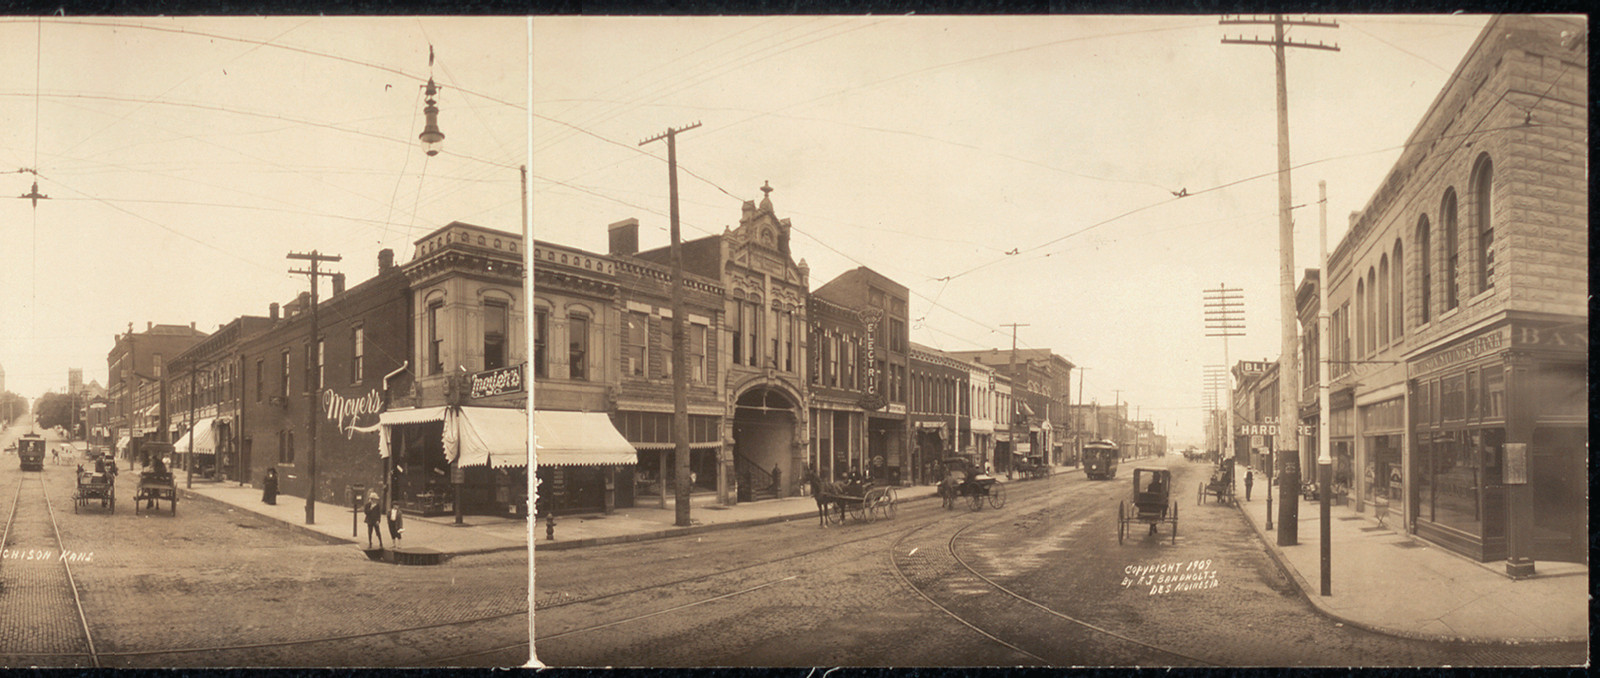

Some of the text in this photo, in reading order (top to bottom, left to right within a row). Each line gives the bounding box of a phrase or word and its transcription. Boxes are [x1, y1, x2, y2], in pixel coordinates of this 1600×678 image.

[867, 323, 875, 395] ELECTRIC
[322, 388, 384, 440] Moyer's
[1241, 425, 1312, 436] HARDRE
